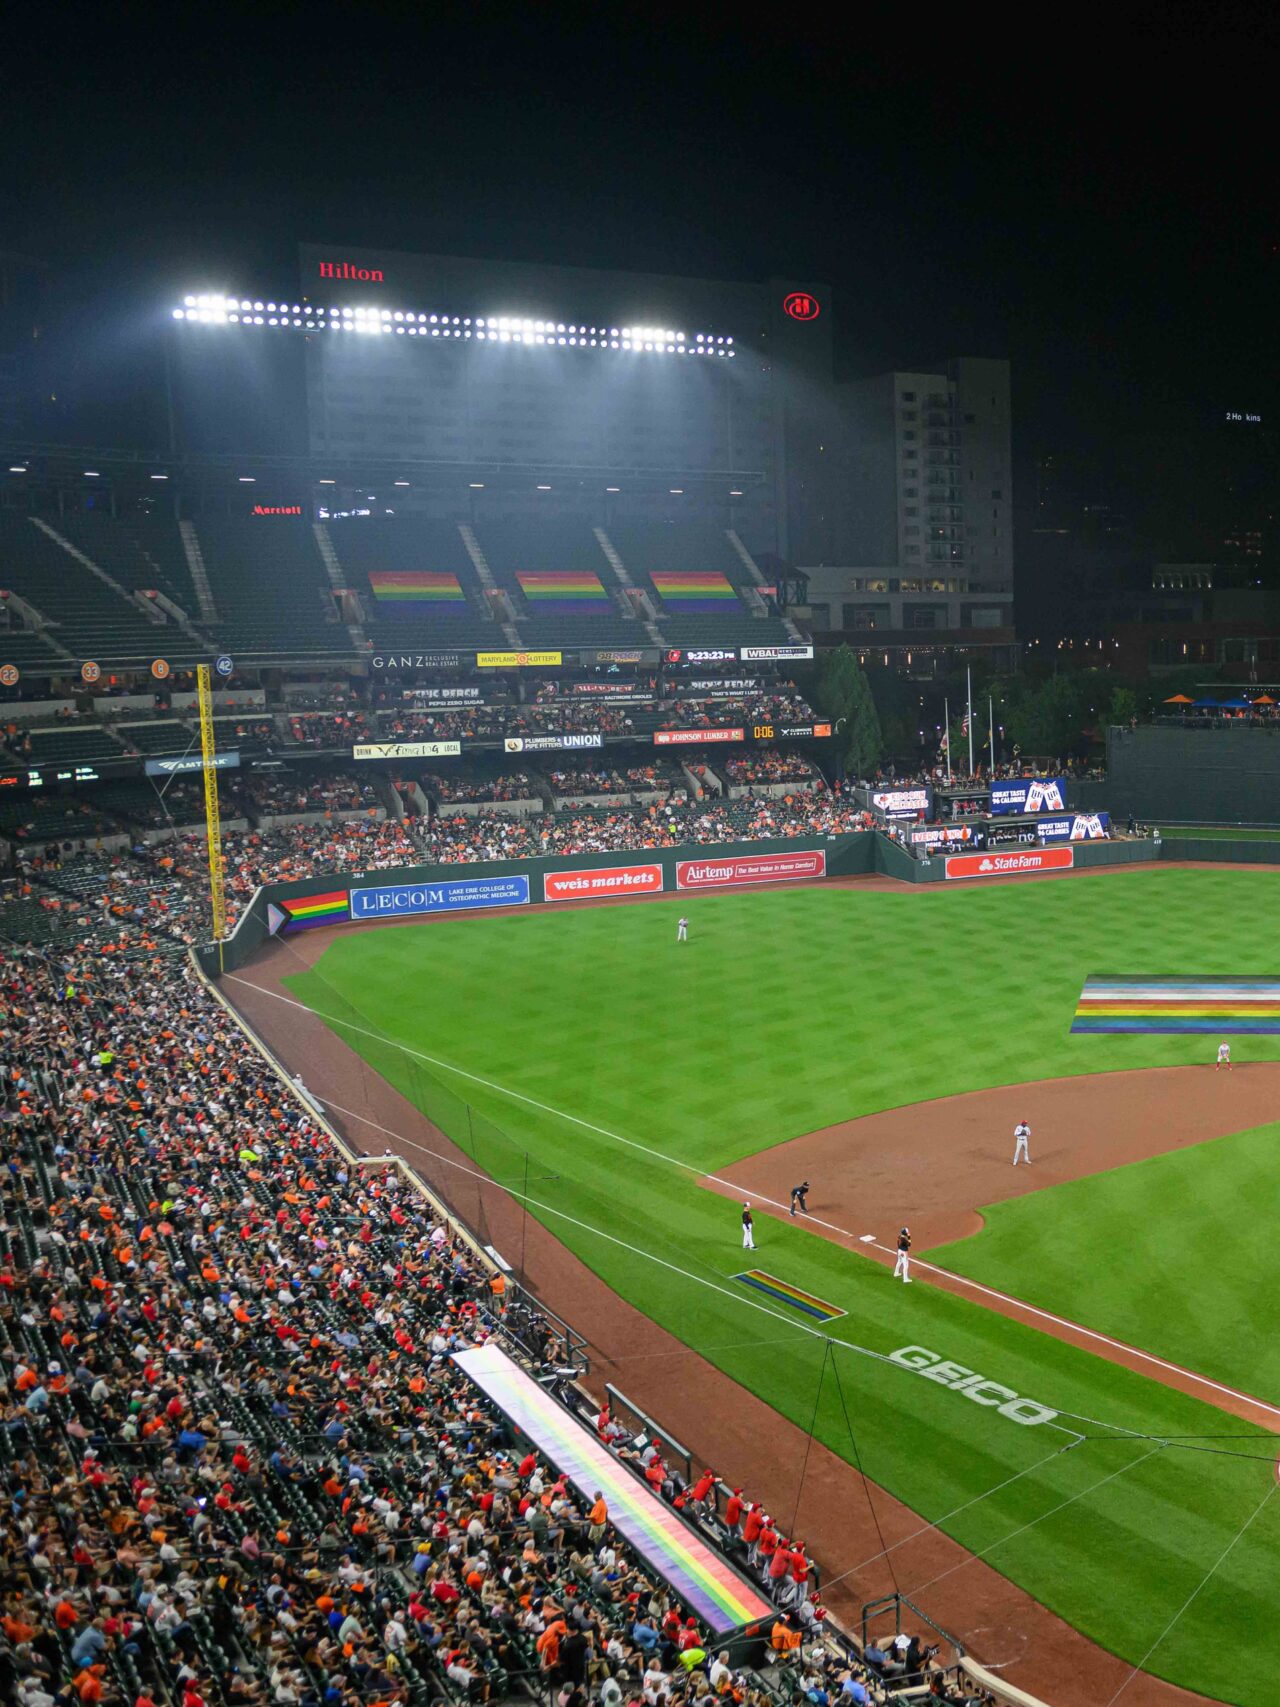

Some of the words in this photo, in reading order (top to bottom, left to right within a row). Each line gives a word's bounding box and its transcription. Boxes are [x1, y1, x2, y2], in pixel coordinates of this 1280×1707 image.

[319, 263, 384, 282] Hilton
[252, 506, 302, 517] Marriott
[481, 655, 515, 663] MARYLAND
[530, 654, 557, 662] LOTTERY
[687, 651, 724, 660] 9:23:23
[748, 650, 777, 658] WBAL
[218, 660, 231, 672] 42
[372, 656, 425, 668] GANZ
[2, 669, 16, 681] 22
[85, 666, 98, 677] 33
[157, 664, 165, 675] 8
[442, 687, 480, 699] PERCH
[672, 733, 702, 741] JOHNSON
[703, 732, 729, 740] LUMBER
[754, 726, 774, 738] 0:06
[539, 741, 563, 749] FITTERS
[563, 734, 602, 747] UNION
[356, 748, 372, 756] DRINK
[444, 744, 459, 752] LOCAL
[177, 758, 228, 769] AMTAK
[992, 790, 1009, 798] GREAT
[1009, 789, 1026, 797] TASTE
[1000, 796, 1026, 804] CALORIES
[912, 831, 939, 842] EVERY
[1046, 828, 1070, 836] CALORIES
[687, 865, 734, 880] Airtemp
[760, 865, 774, 873] Value
[554, 877, 590, 891] weis
[592, 872, 655, 887] markets
[479, 885, 506, 893] COLLEGE
[449, 893, 490, 902] OSTEOPATHIC
[490, 890, 520, 899] MEDICINE
[889, 1345, 1059, 1425] GEICO
